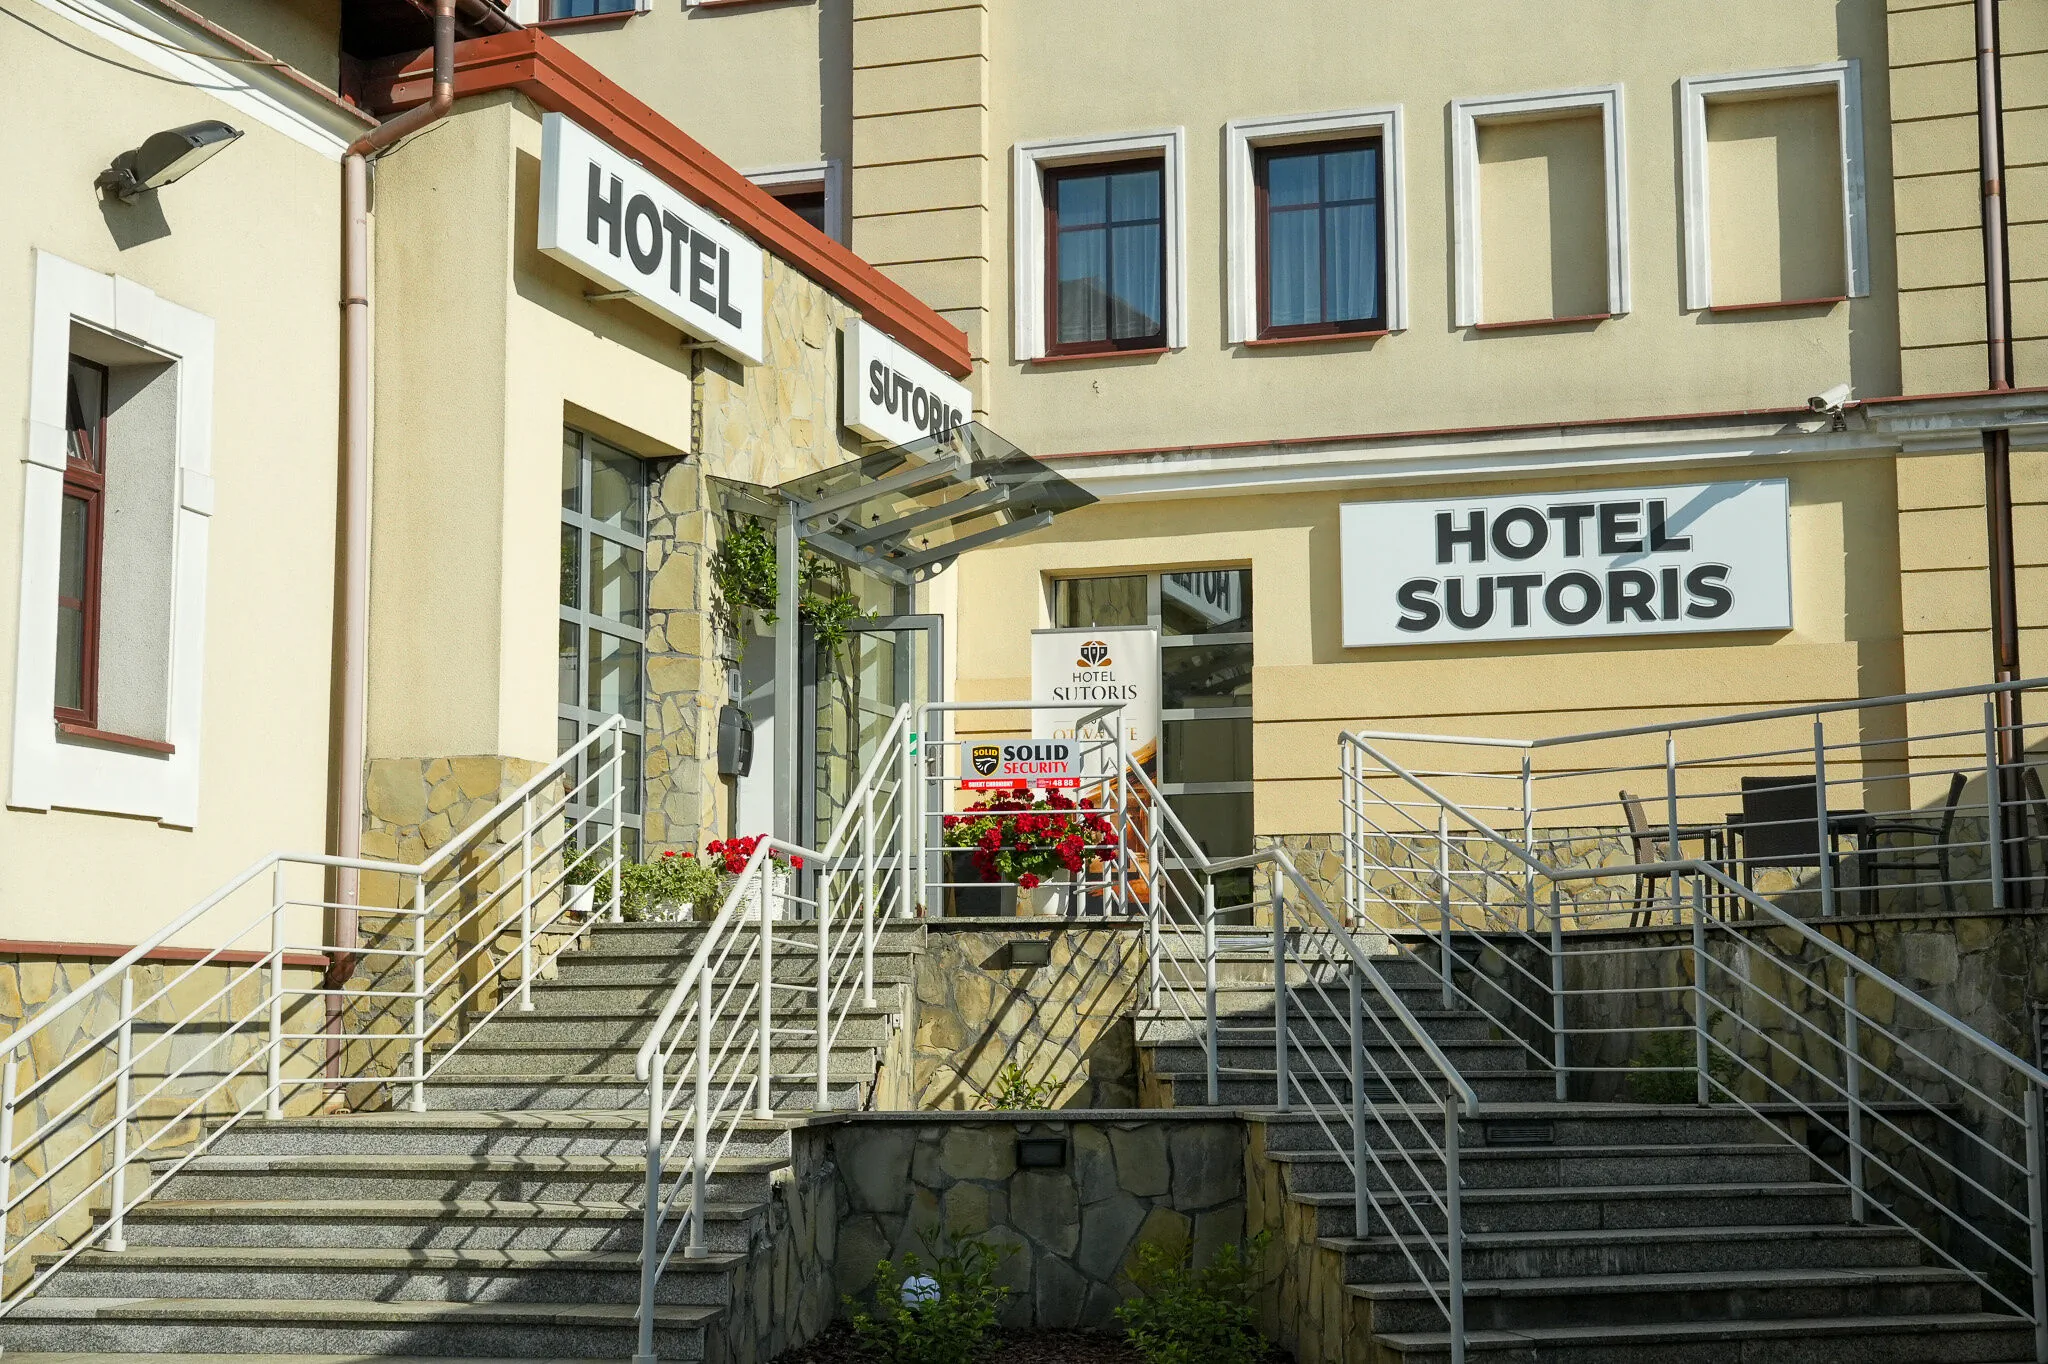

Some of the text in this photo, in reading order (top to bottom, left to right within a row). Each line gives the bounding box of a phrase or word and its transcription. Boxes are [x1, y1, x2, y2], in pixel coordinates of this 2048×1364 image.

[586, 160, 742, 329] HOTEL
[869, 359, 963, 445] SUTORIS
[1435, 498, 1692, 564] HOTEL
[1395, 564, 1735, 631] SUTORIS
[1072, 671, 1115, 682] HOTEL
[1053, 684, 1137, 700] SUTORIS
[974, 748, 998, 756] SOLID
[1003, 745, 1069, 761] SOLID
[1003, 761, 1069, 775] SECURITY
[1052, 779, 1063, 787] 48
